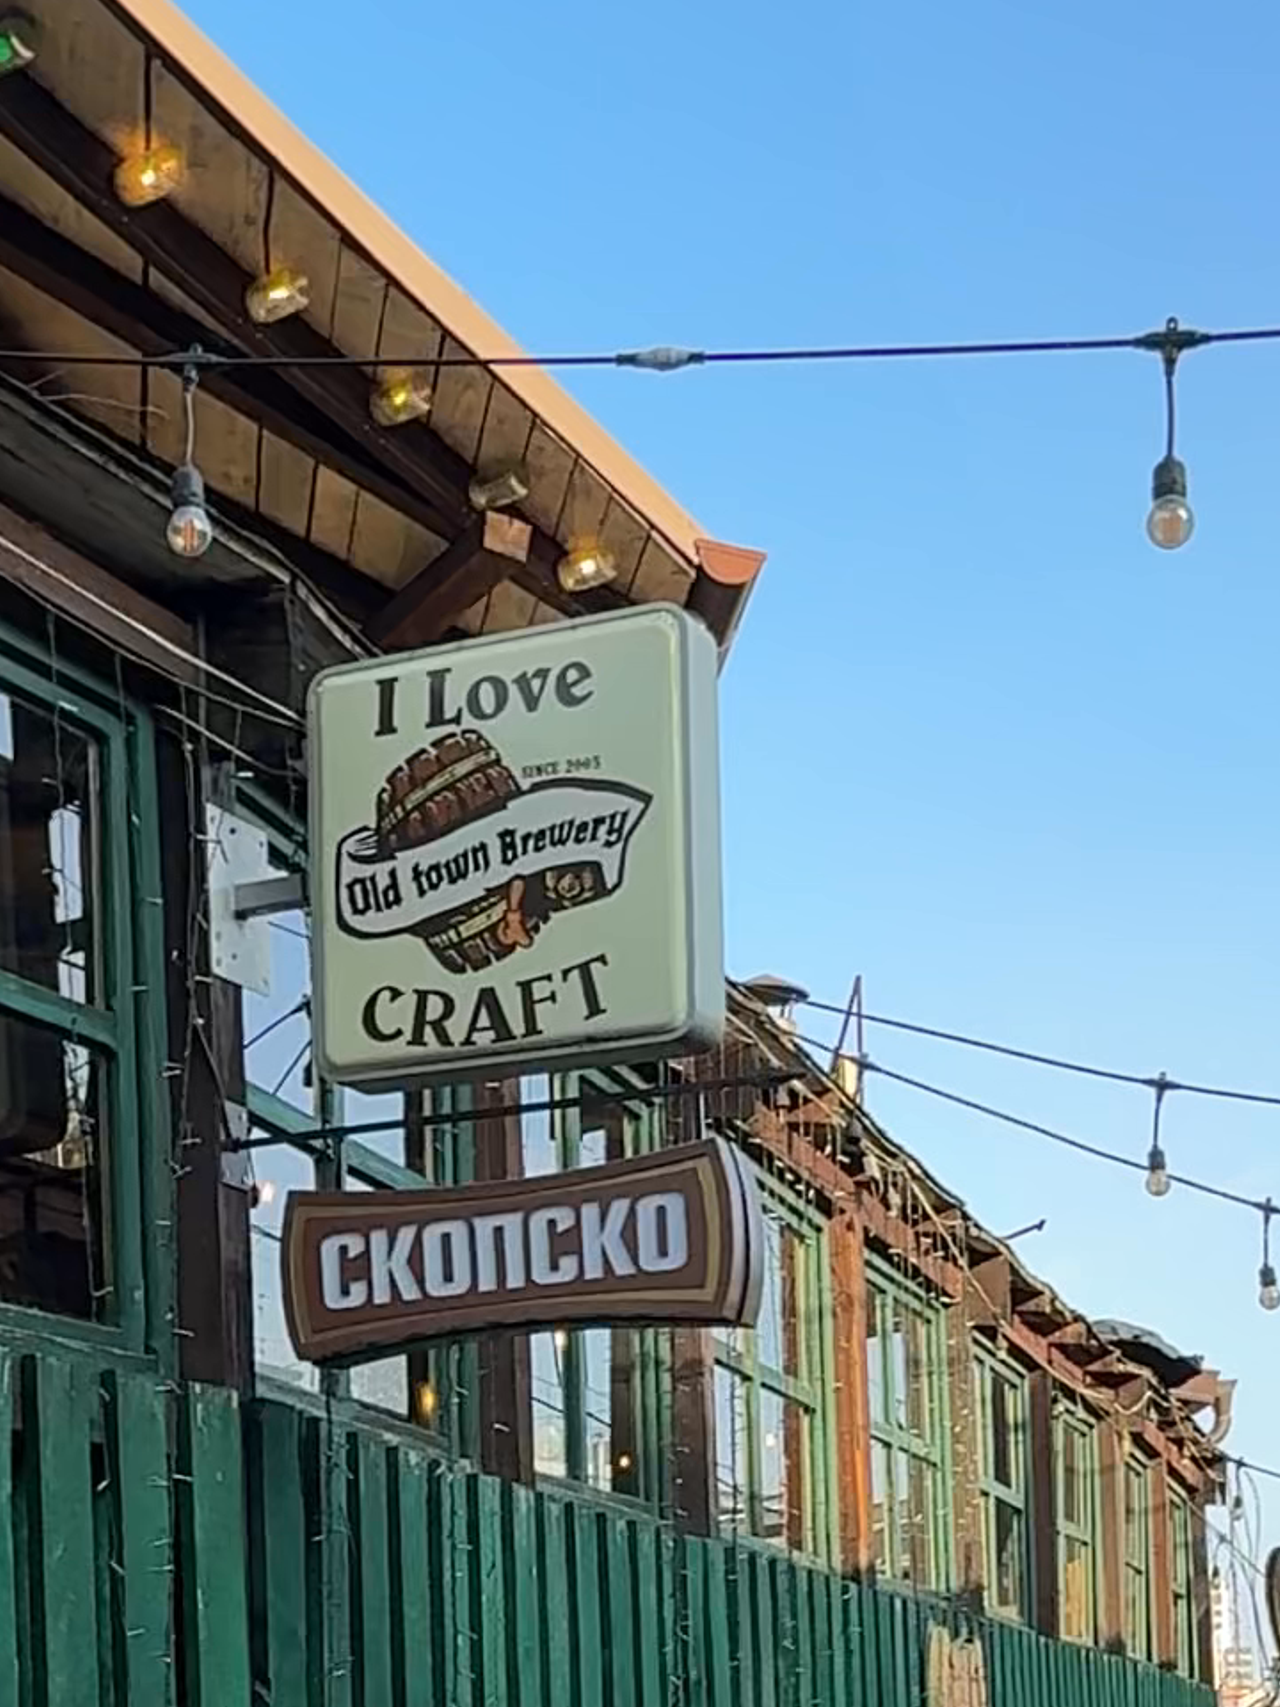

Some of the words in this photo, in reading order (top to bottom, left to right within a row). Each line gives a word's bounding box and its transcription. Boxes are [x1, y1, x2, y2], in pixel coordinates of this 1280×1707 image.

[375, 677, 399, 737] I
[425, 660, 594, 729] Love
[521, 760, 560, 780] SINCE
[346, 867, 402, 917] Old
[412, 841, 490, 898] town
[497, 808, 631, 867] Brewery
[361, 953, 610, 1048] CRAFT
[320, 1191, 689, 1311] СКОПСКО
